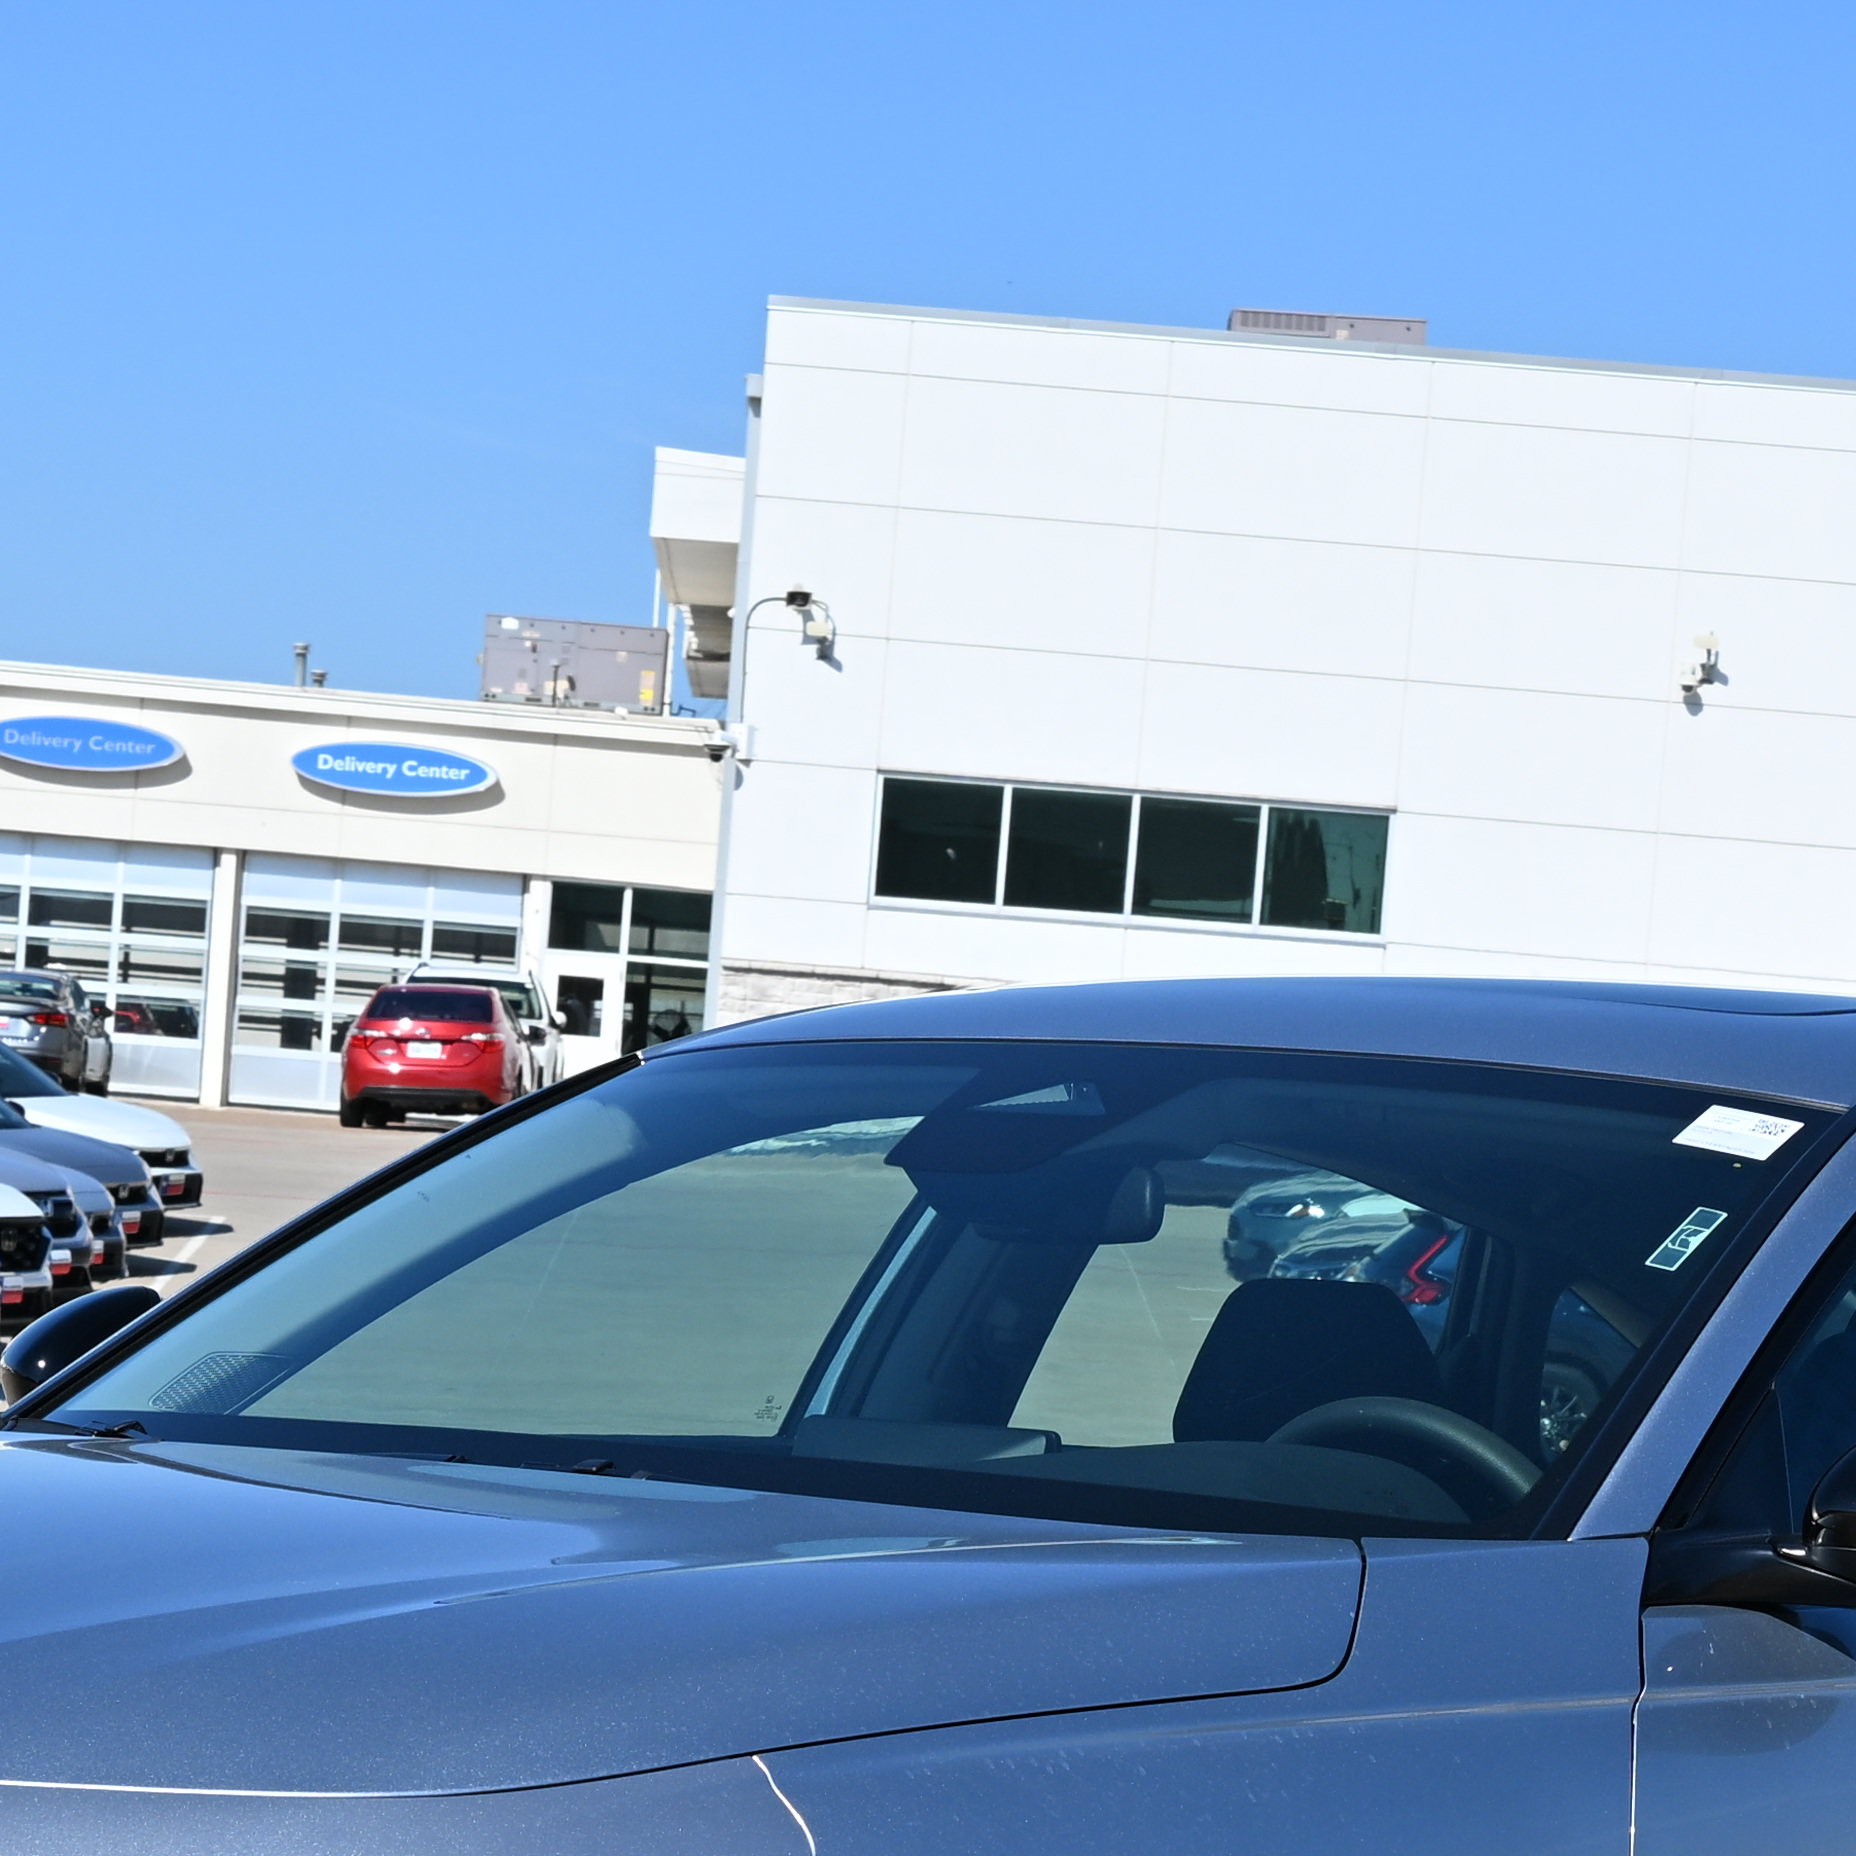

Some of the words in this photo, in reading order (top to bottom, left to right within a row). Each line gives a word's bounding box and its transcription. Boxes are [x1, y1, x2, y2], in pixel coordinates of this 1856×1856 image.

[4, 728, 83, 753] Delivery
[88, 735, 156, 754] Center
[317, 753, 398, 779] Delivery
[401, 760, 470, 780] Center
